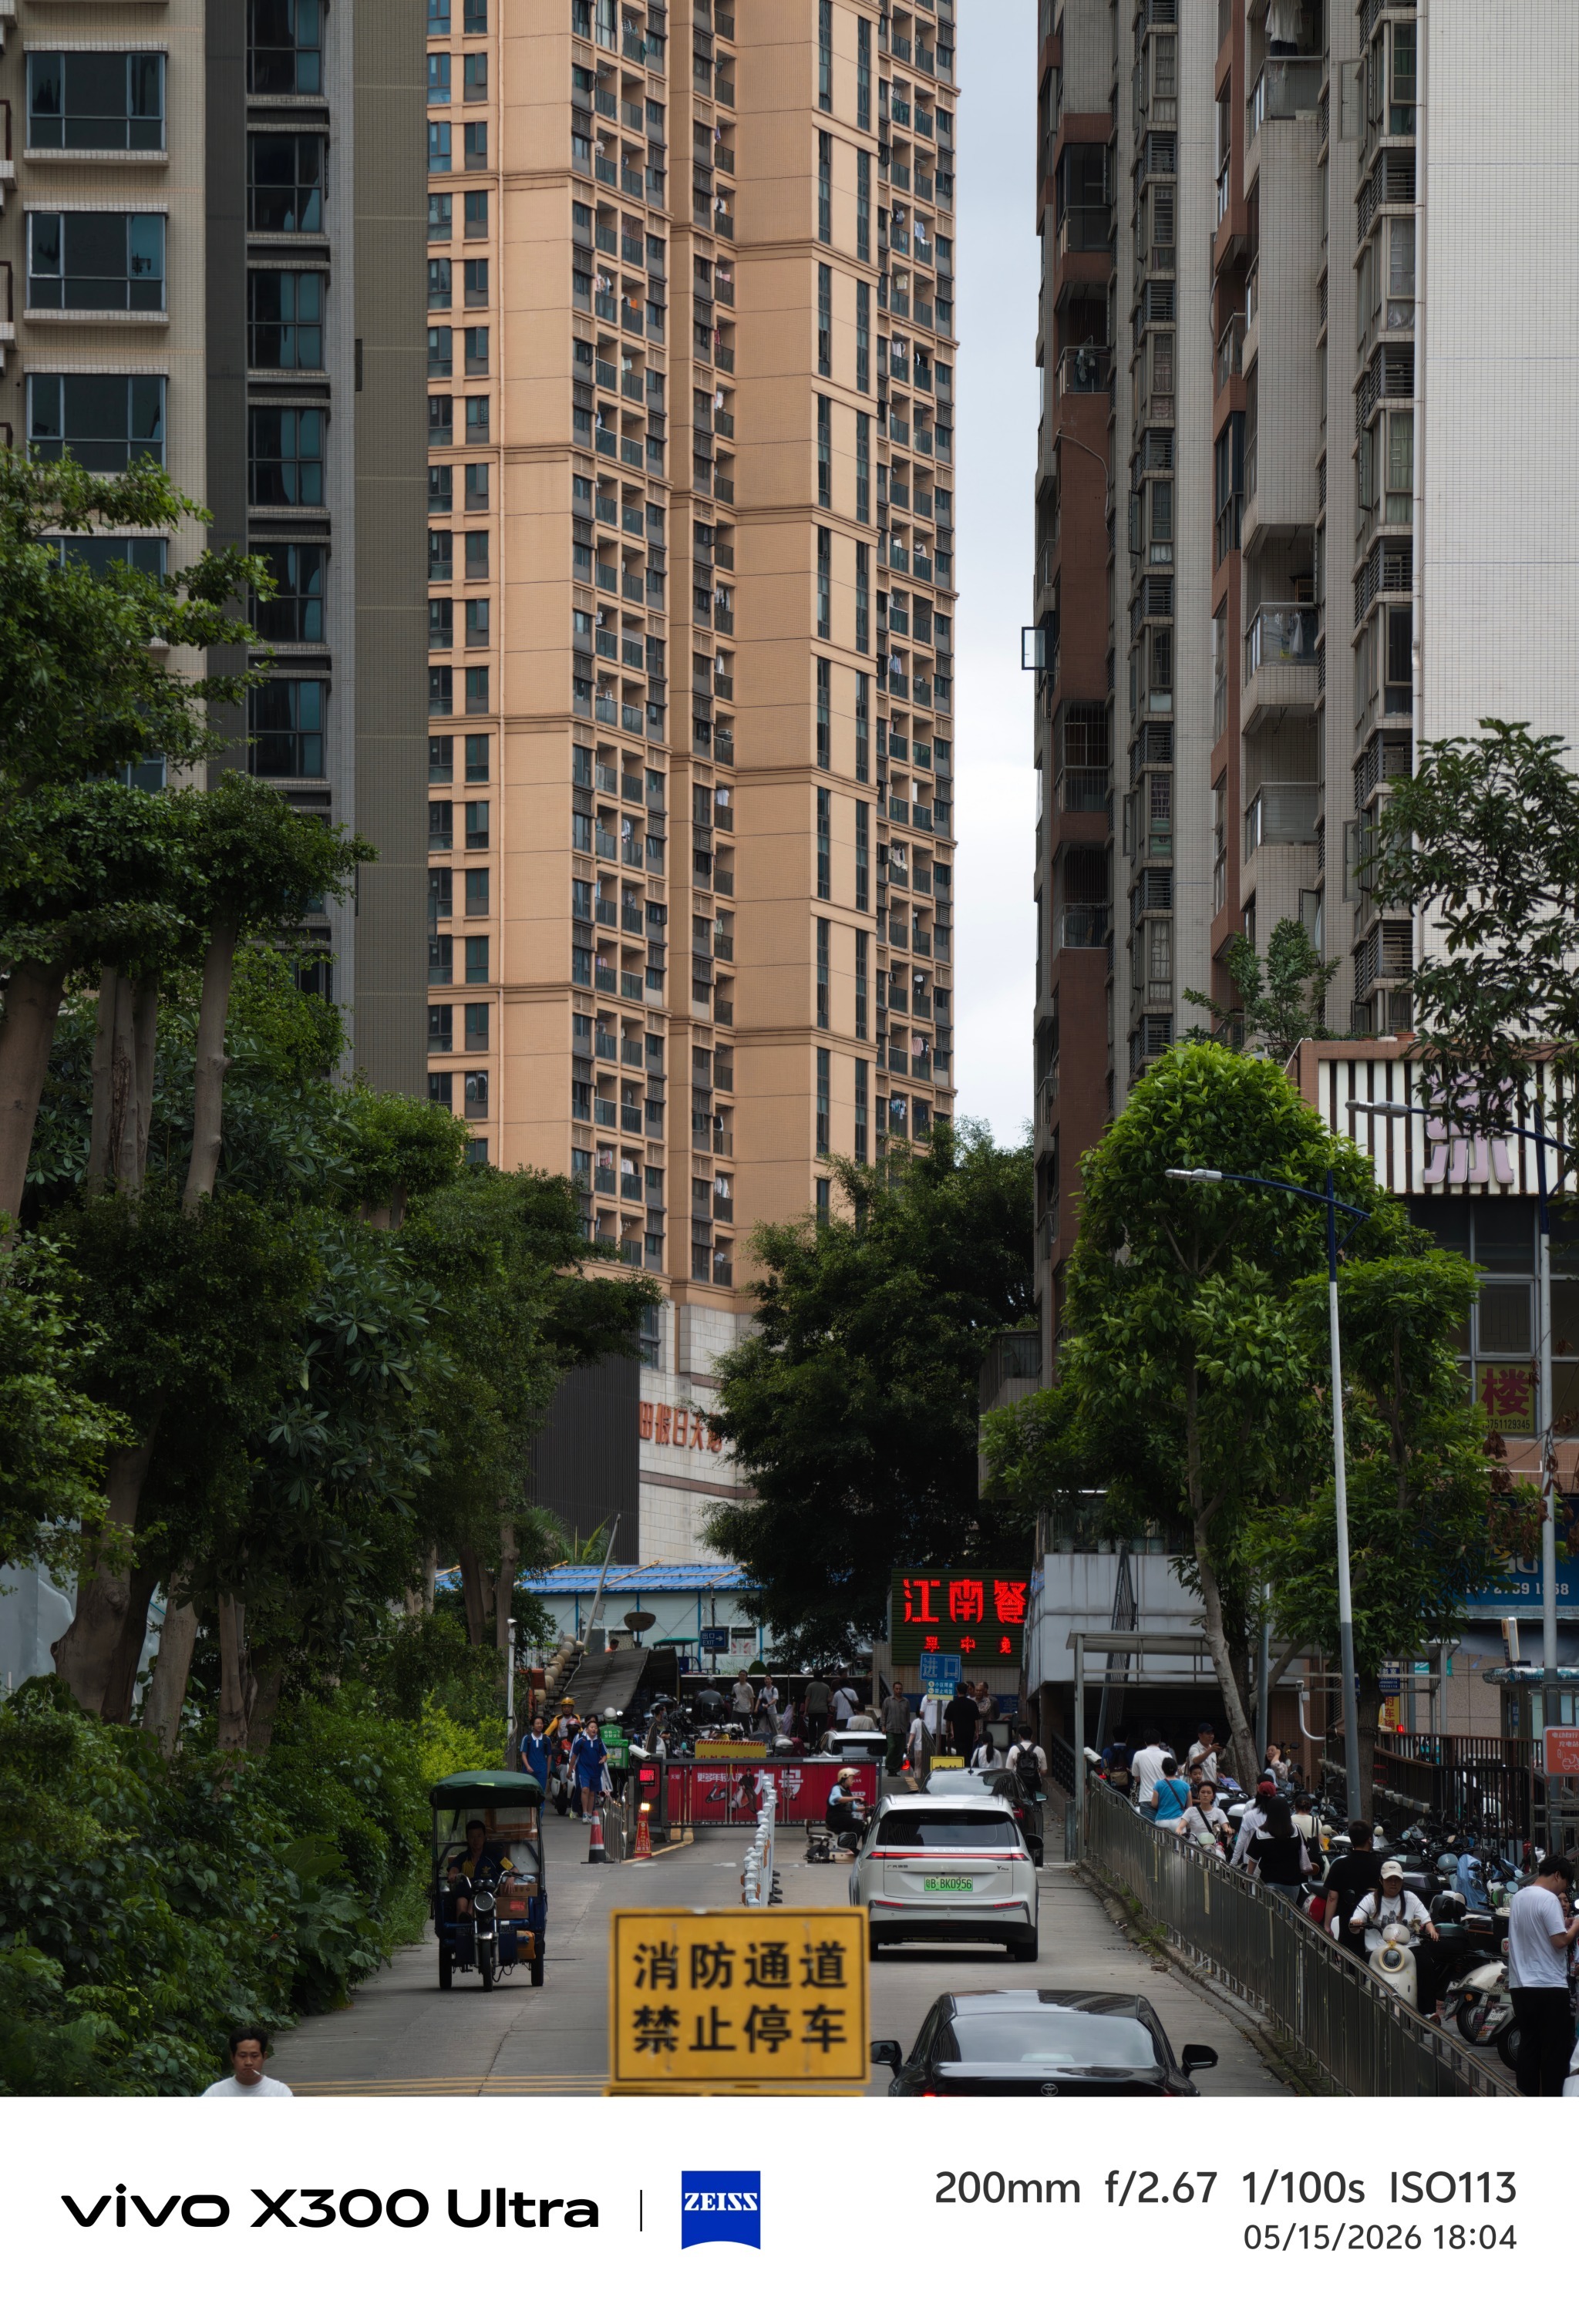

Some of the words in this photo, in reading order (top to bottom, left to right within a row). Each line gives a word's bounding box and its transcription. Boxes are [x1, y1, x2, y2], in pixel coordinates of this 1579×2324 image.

[1481, 1368, 1529, 1417] 楼
[903, 1579, 1027, 1623] 江南餐
[922, 1657, 958, 1678] 进口
[632, 1941, 848, 1990] 消防通道
[631, 2003, 848, 2054] 禁止停车
